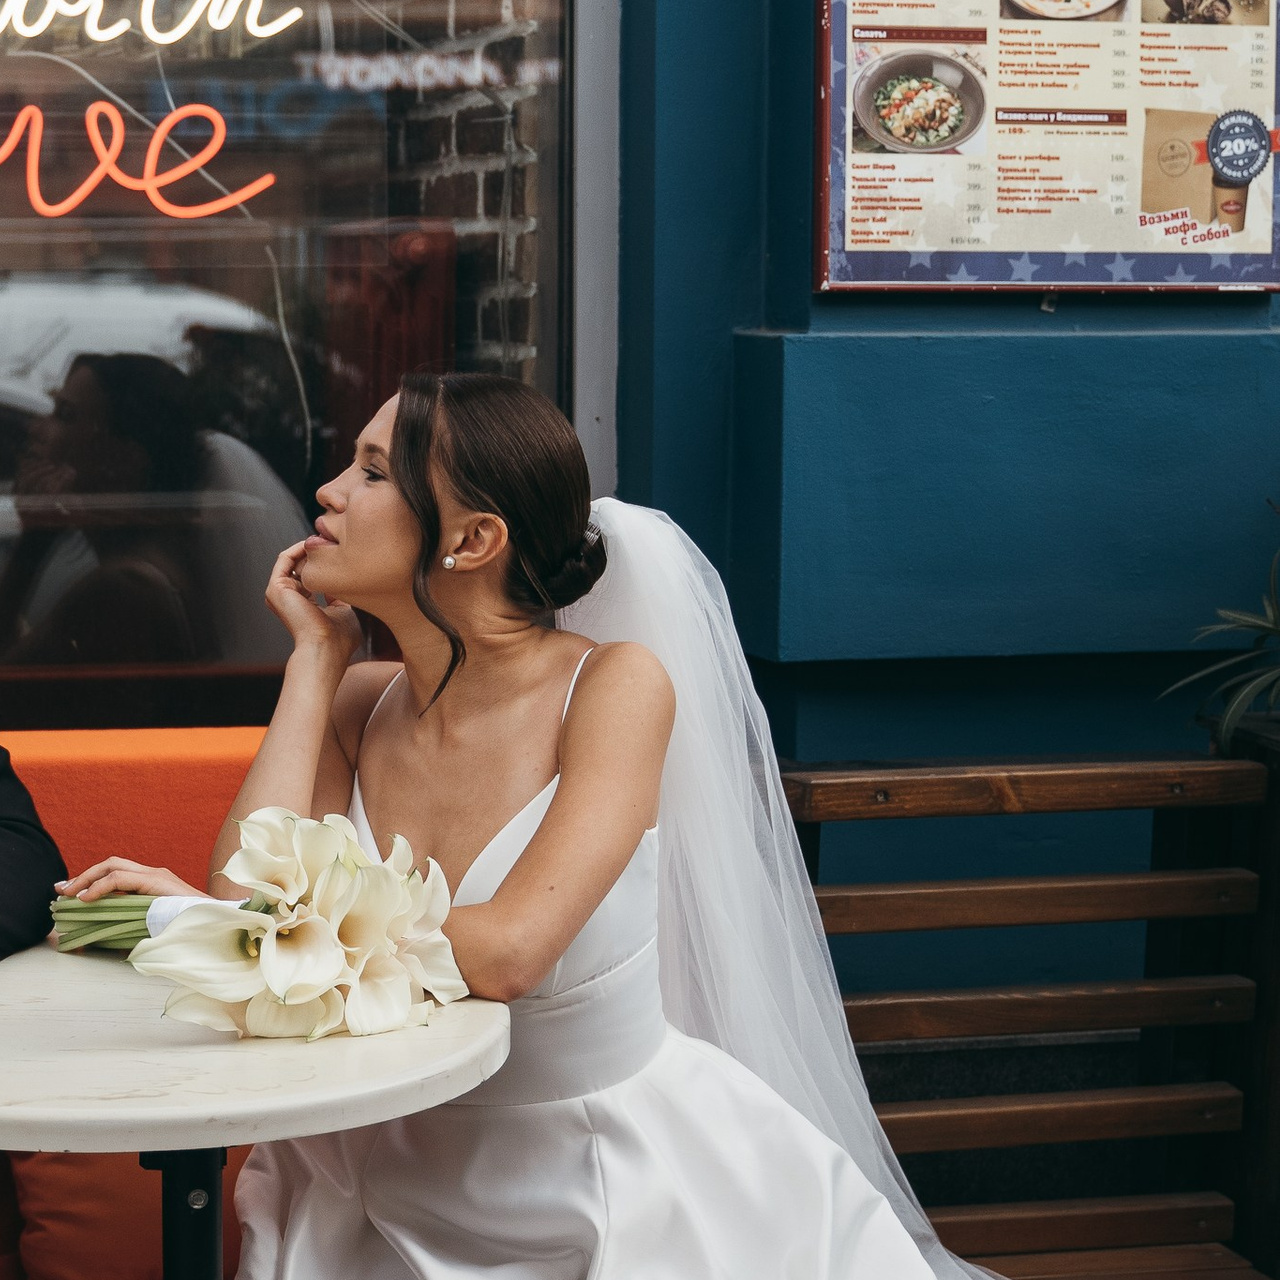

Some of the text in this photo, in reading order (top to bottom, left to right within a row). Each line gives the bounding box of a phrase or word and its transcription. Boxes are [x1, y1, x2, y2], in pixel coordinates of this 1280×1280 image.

[1220, 137, 1259, 157] 20%
[1139, 209, 1188, 227] Возьми
[1164, 222, 1198, 236] кофе
[1181, 228, 1230, 246] с собой
